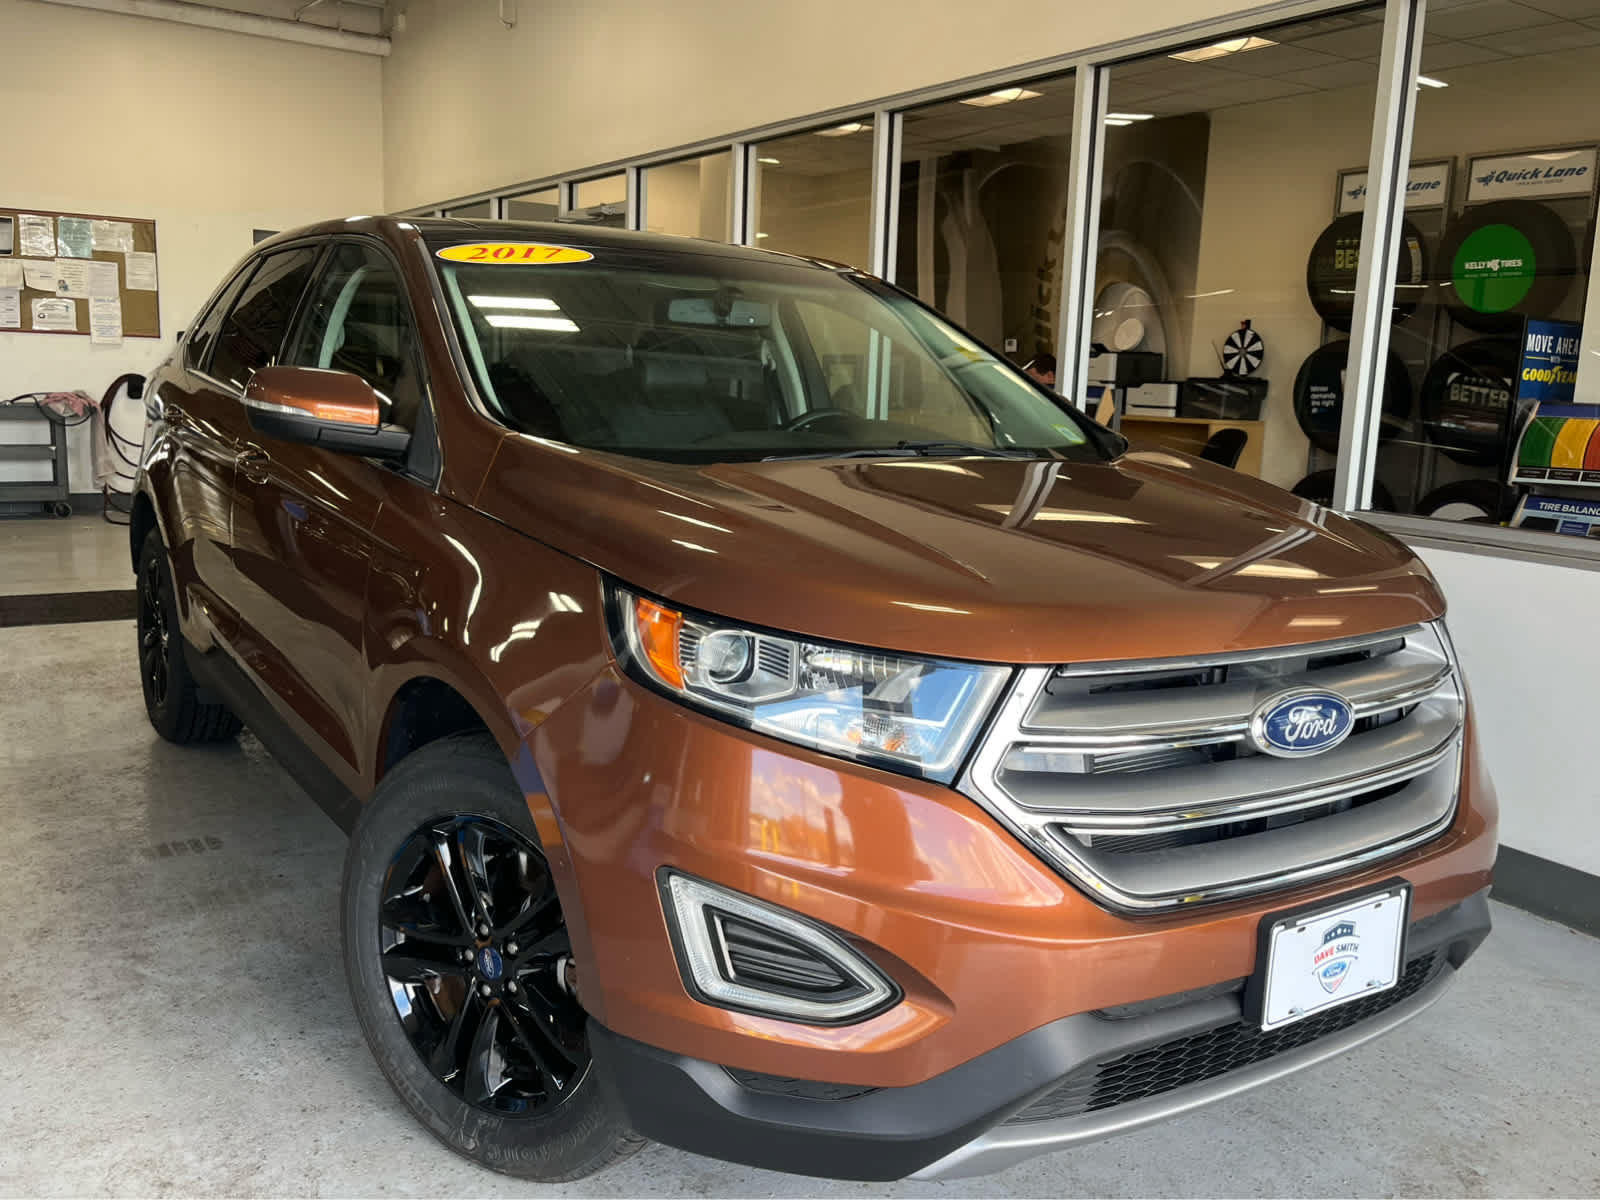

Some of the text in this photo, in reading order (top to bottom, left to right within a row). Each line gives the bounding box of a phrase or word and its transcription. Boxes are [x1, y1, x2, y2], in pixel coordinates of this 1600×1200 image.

[1496, 165, 1588, 184] Quick Lane
[1405, 180, 1441, 192] Lane
[467, 247, 563, 260] 2017
[1335, 249, 1359, 269] BE
[1526, 333, 1580, 356] MOVE AHEA
[1450, 383, 1510, 409] BETTER
[1539, 501, 1562, 512] TIRE
[1284, 703, 1337, 742] Ford
[1314, 943, 1360, 965] DAVE SMITH
